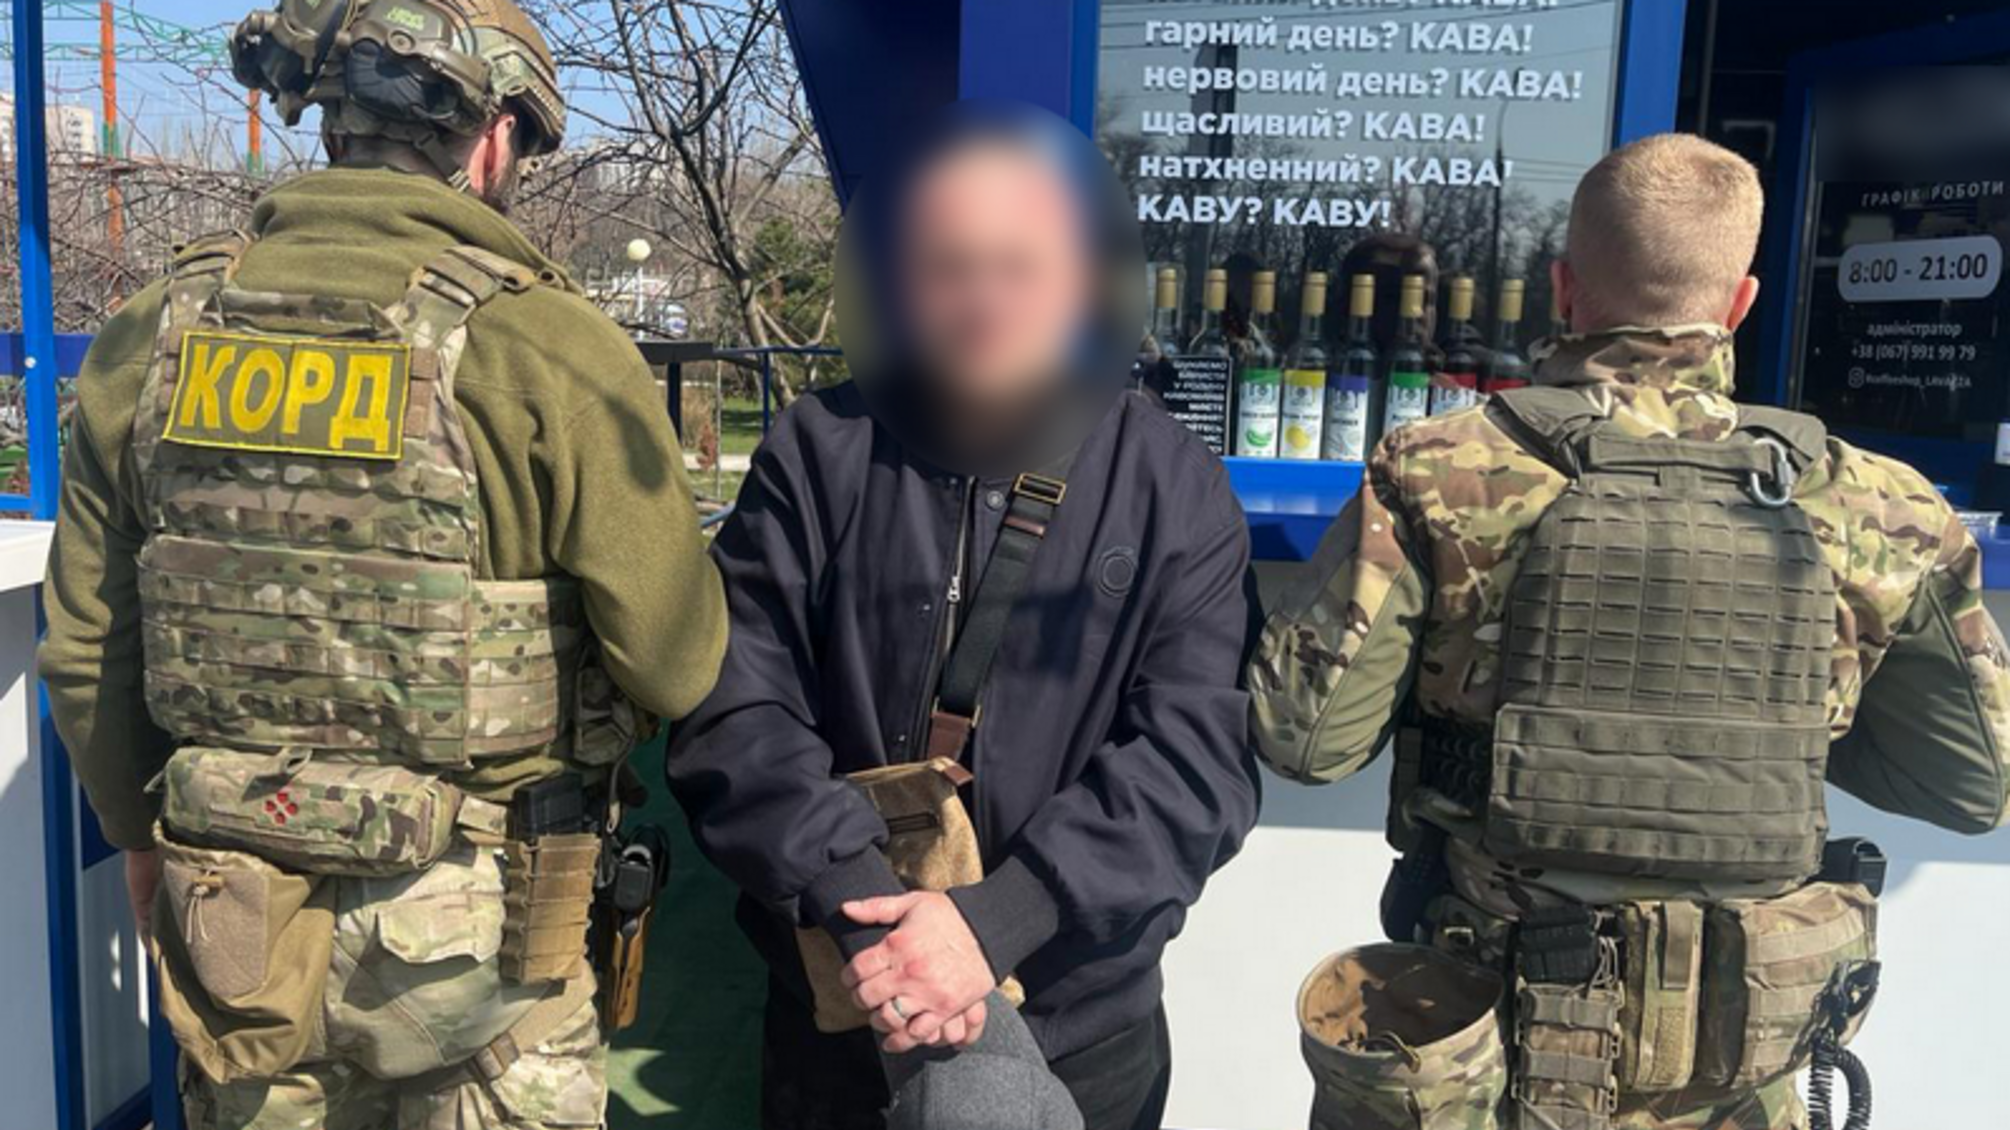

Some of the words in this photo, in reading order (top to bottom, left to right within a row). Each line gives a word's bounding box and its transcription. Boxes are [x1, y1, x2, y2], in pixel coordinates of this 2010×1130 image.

[1145, 16, 1277, 49] гарний
[1287, 20, 1399, 51] день?
[1410, 21, 1533, 52] КАВА!
[1143, 62, 1327, 94] нервовий
[1337, 67, 1449, 97] день?
[1460, 68, 1583, 99] КАВА!
[1142, 107, 1353, 137] щасливий?
[1364, 112, 1486, 141] КАВА!
[1139, 153, 1381, 183] натхненний?
[1861, 188, 1921, 207] ГРАФІК
[1931, 181, 2004, 201] РОБОТИ
[1137, 195, 1263, 224] КАВУ?
[1273, 198, 1392, 227] КАВУ!
[1848, 259, 1898, 284] 8:00
[1918, 253, 1988, 281] 21:00
[1866, 320, 1963, 339] адміністратор
[1851, 344, 1873, 359] +38
[1875, 343, 1909, 361] (067)
[1910, 344, 1934, 360] 991
[1938, 345, 1956, 361] 99
[1958, 345, 1977, 361] 79
[179, 344, 393, 452] КОРД
